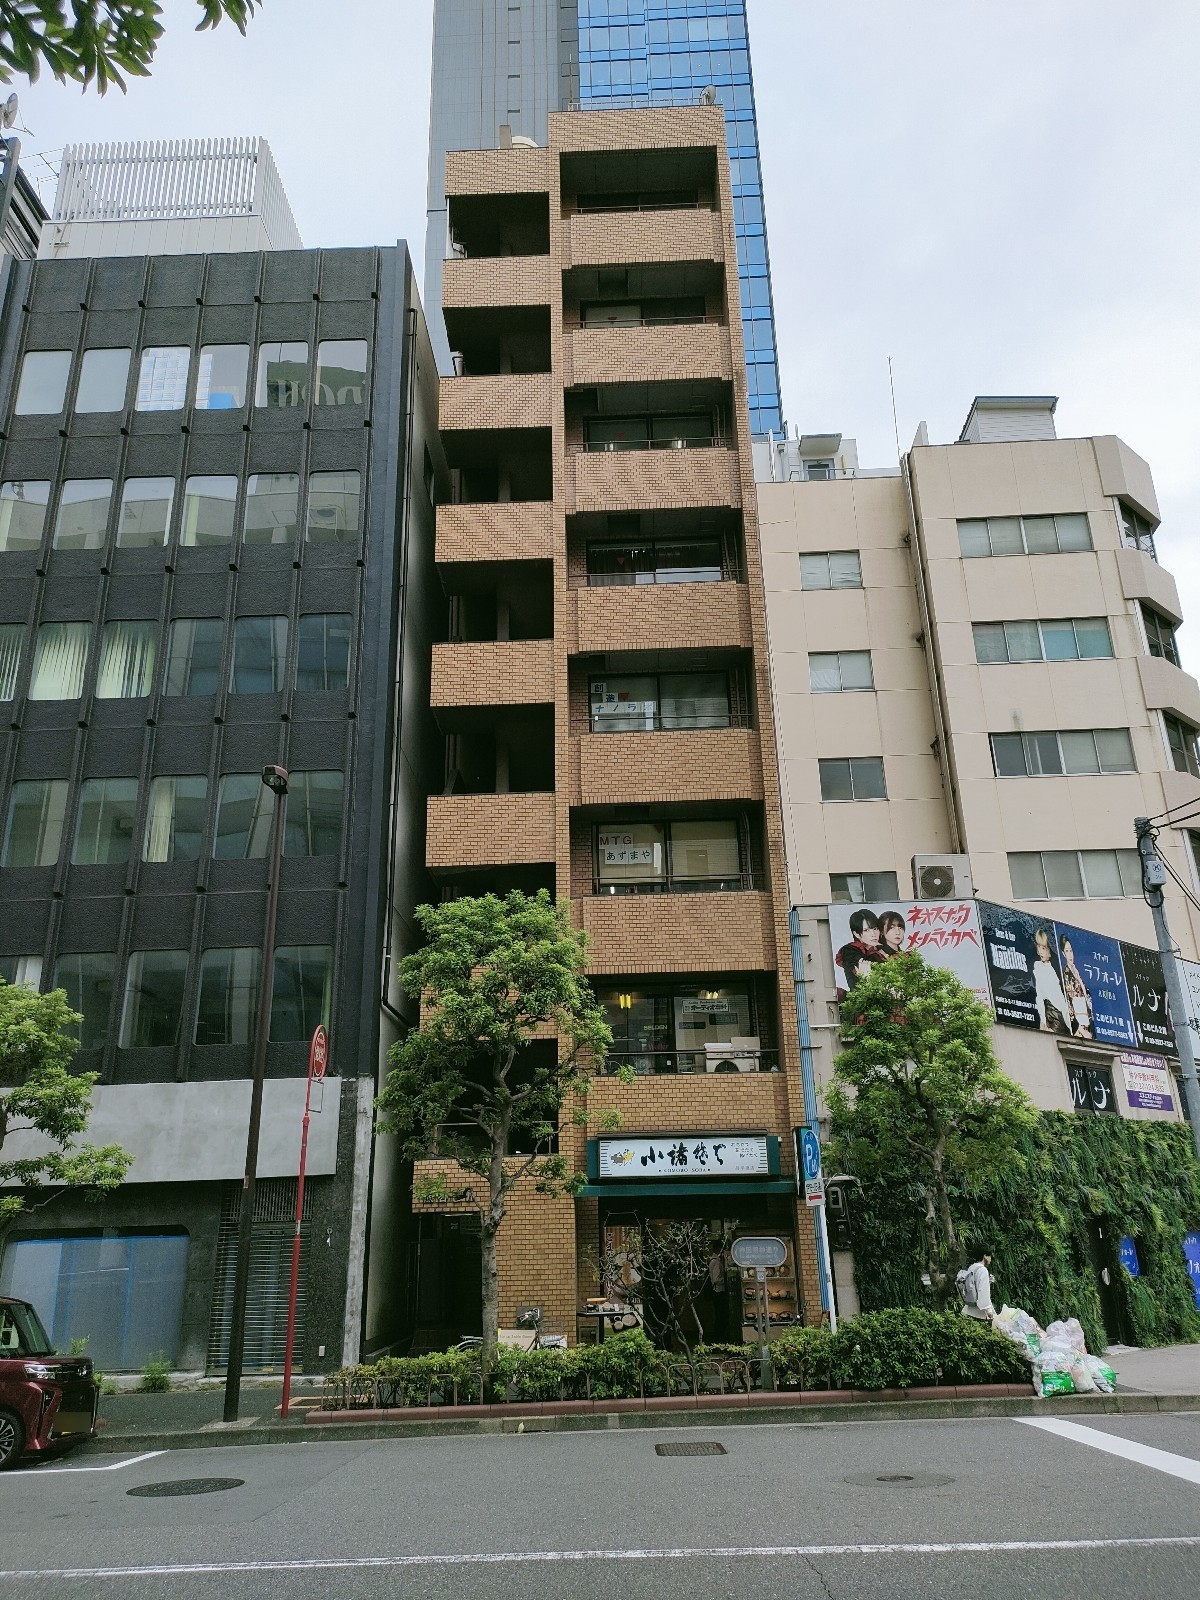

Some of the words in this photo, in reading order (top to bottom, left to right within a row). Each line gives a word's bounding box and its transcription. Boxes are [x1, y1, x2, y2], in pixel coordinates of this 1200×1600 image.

[600, 835, 632, 846] MTG
[906, 903, 972, 929] ネオスナック
[990, 942, 1028, 973] Nautilus
[1092, 951, 1109, 964] スナック
[1083, 963, 1122, 986] ラフォーレ
[1132, 984, 1161, 1011] ルナ
[1071, 1077, 1110, 1109] ルナ
